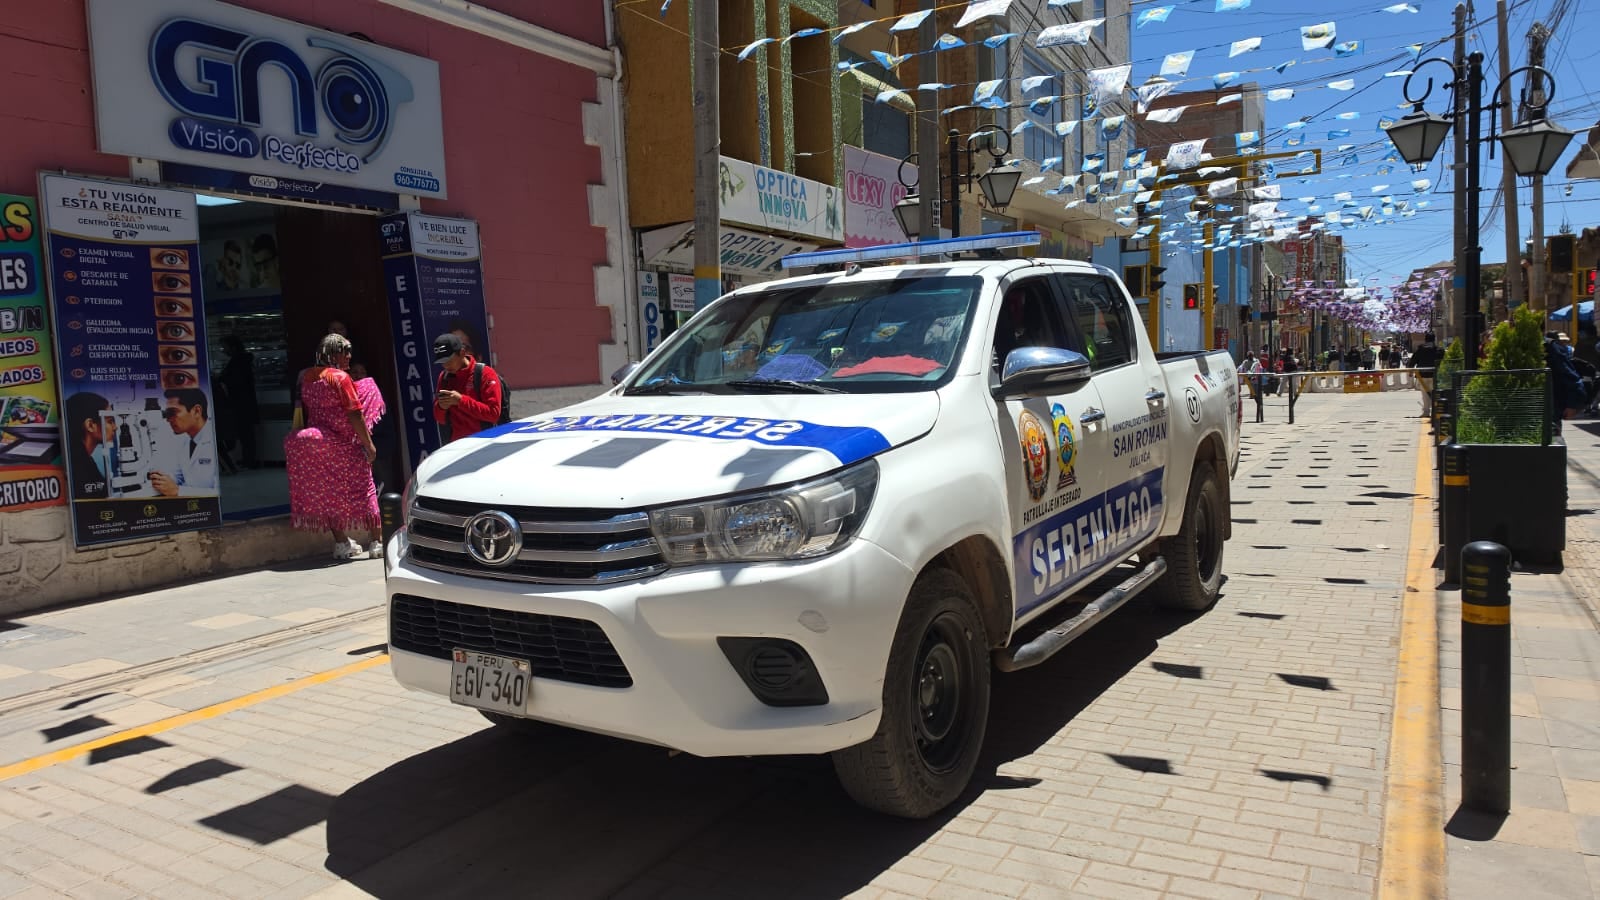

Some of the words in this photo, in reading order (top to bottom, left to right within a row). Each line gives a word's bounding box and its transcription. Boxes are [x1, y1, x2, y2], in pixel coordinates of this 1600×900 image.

[180, 121, 253, 155] Visión
[266, 135, 360, 172] Perfecta
[757, 168, 808, 201] OPTICA
[847, 170, 886, 208] LEXY
[112, 190, 157, 205] VISIÓN
[62, 197, 99, 210] ESTA
[103, 202, 182, 218] REALMENTE
[78, 218, 109, 227] CENTRO
[121, 222, 145, 230] SALUD
[146, 224, 170, 232] VISUAL
[431, 223, 448, 233] BIEN
[450, 226, 467, 235] LUCE
[720, 232, 784, 256] OPTICA
[79, 248, 108, 256] EXAMEN
[110, 250, 135, 258] VISUAL
[80, 256, 108, 264] DIGITAL
[81, 270, 118, 278] DESCARTE
[81, 279, 118, 287] CATARATA
[645, 302, 658, 352] OP
[89, 351, 117, 359] CUERPO
[118, 351, 149, 359] EXTRAÑO
[90, 373, 127, 381] MOLESTIAS
[128, 373, 158, 381] VISUALES
[1188, 396, 1199, 415] 07
[1113, 432, 1134, 458] SAN
[1135, 421, 1167, 450] ROMAN
[1129, 451, 1151, 468] JULIACA
[1023, 499, 1054, 525] PATRULLAJE
[1054, 487, 1081, 509] INTEGRADO
[1032, 486, 1151, 596] SERENAZGO
[477, 655, 504, 669] PERU
